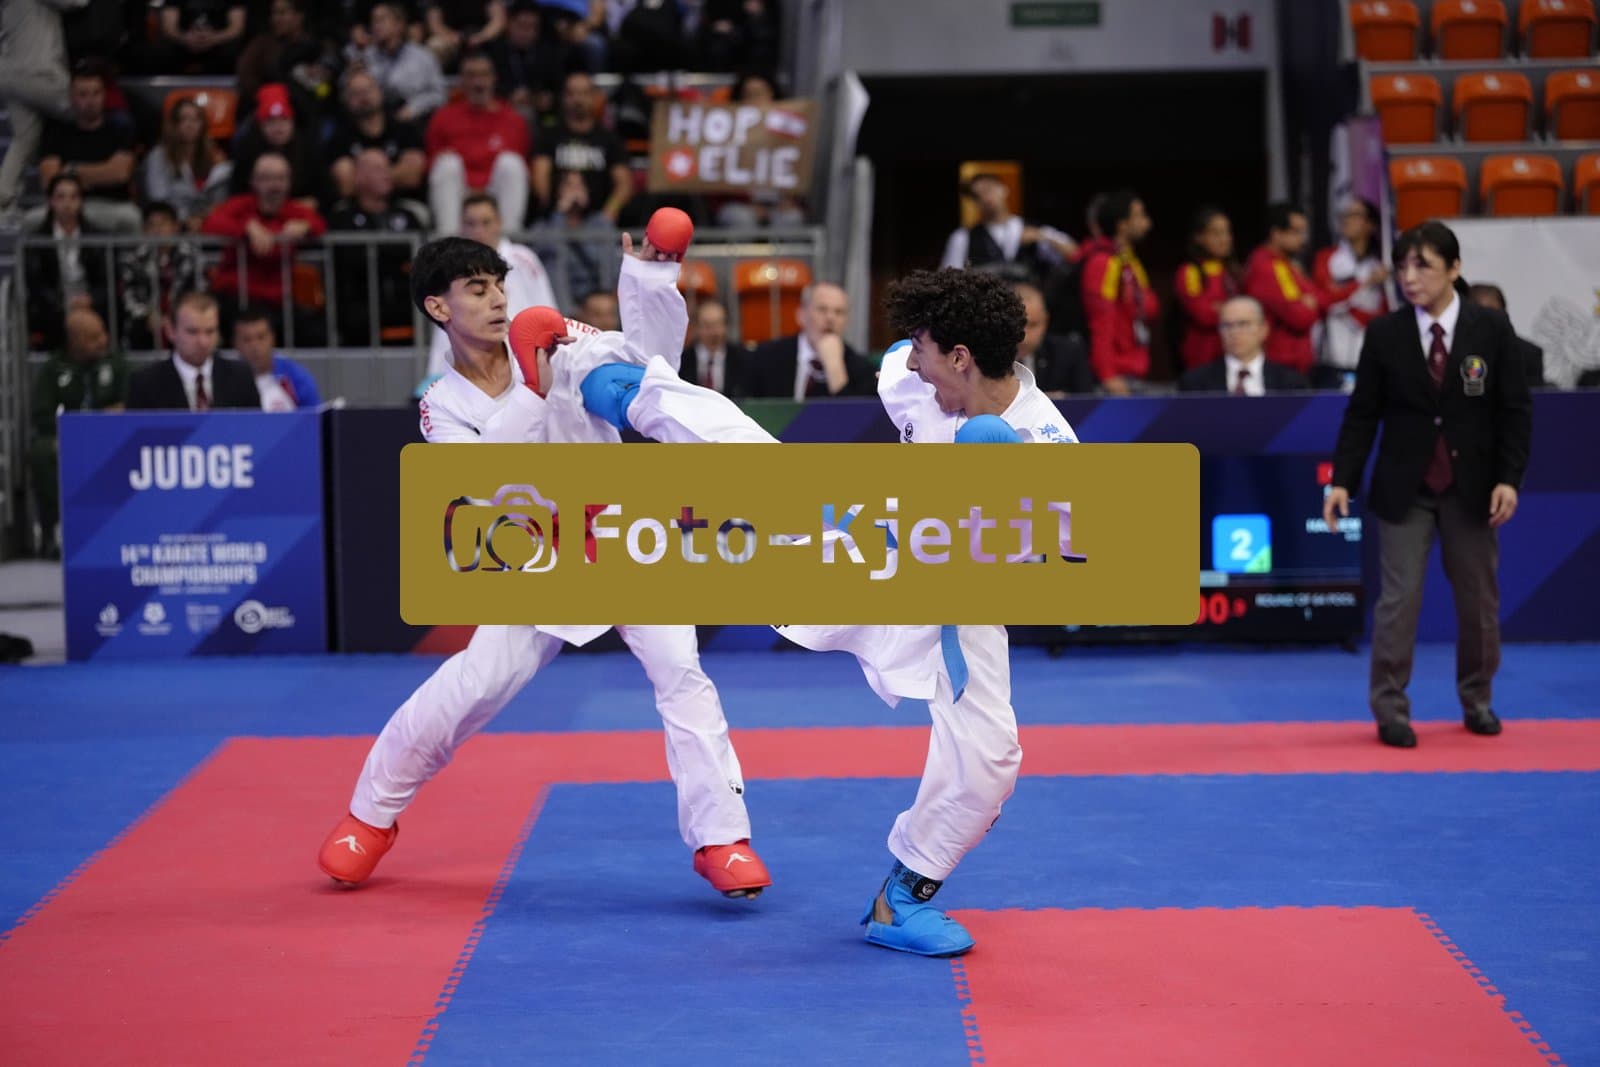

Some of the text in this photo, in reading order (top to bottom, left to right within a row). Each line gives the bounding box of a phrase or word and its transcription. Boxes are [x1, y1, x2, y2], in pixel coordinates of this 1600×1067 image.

[667, 102, 762, 145] HOP
[699, 145, 800, 189] ELIE
[129, 445, 254, 490] JUDGE
[152, 543, 208, 564] KARATE
[211, 542, 267, 563] WORLD
[1230, 528, 1253, 561] 2
[131, 564, 258, 586] CHAMPIONSHIPS
